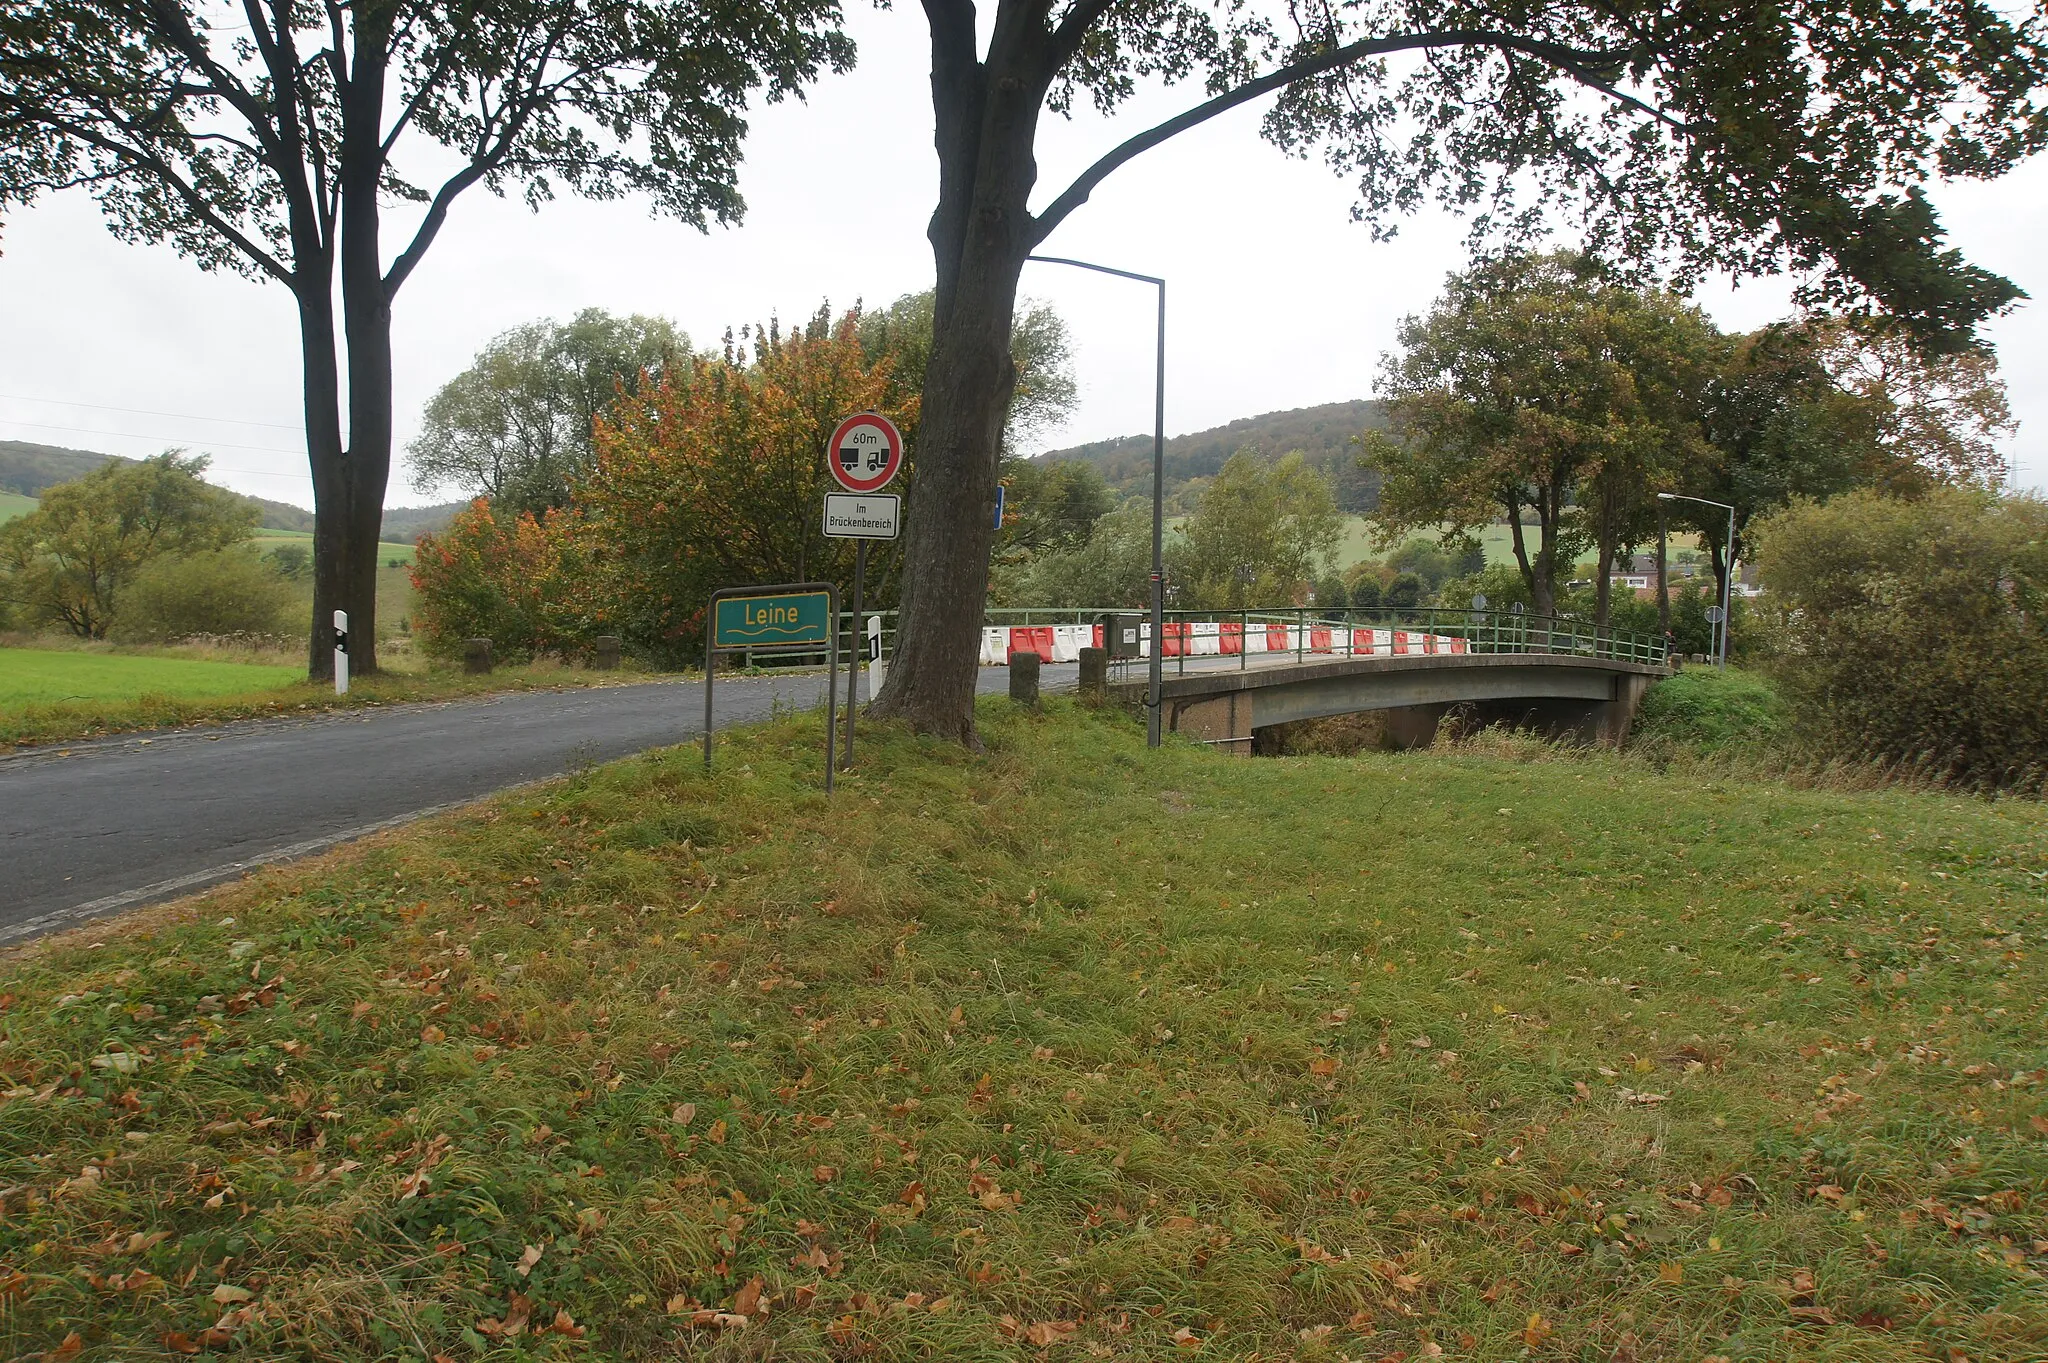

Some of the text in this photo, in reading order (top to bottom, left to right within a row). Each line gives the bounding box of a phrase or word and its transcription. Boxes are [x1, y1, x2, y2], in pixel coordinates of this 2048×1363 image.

[853, 433, 877, 444] 60m
[856, 503, 866, 514] Im
[830, 516, 892, 529] Brückenbereich
[745, 602, 798, 625] Leine
